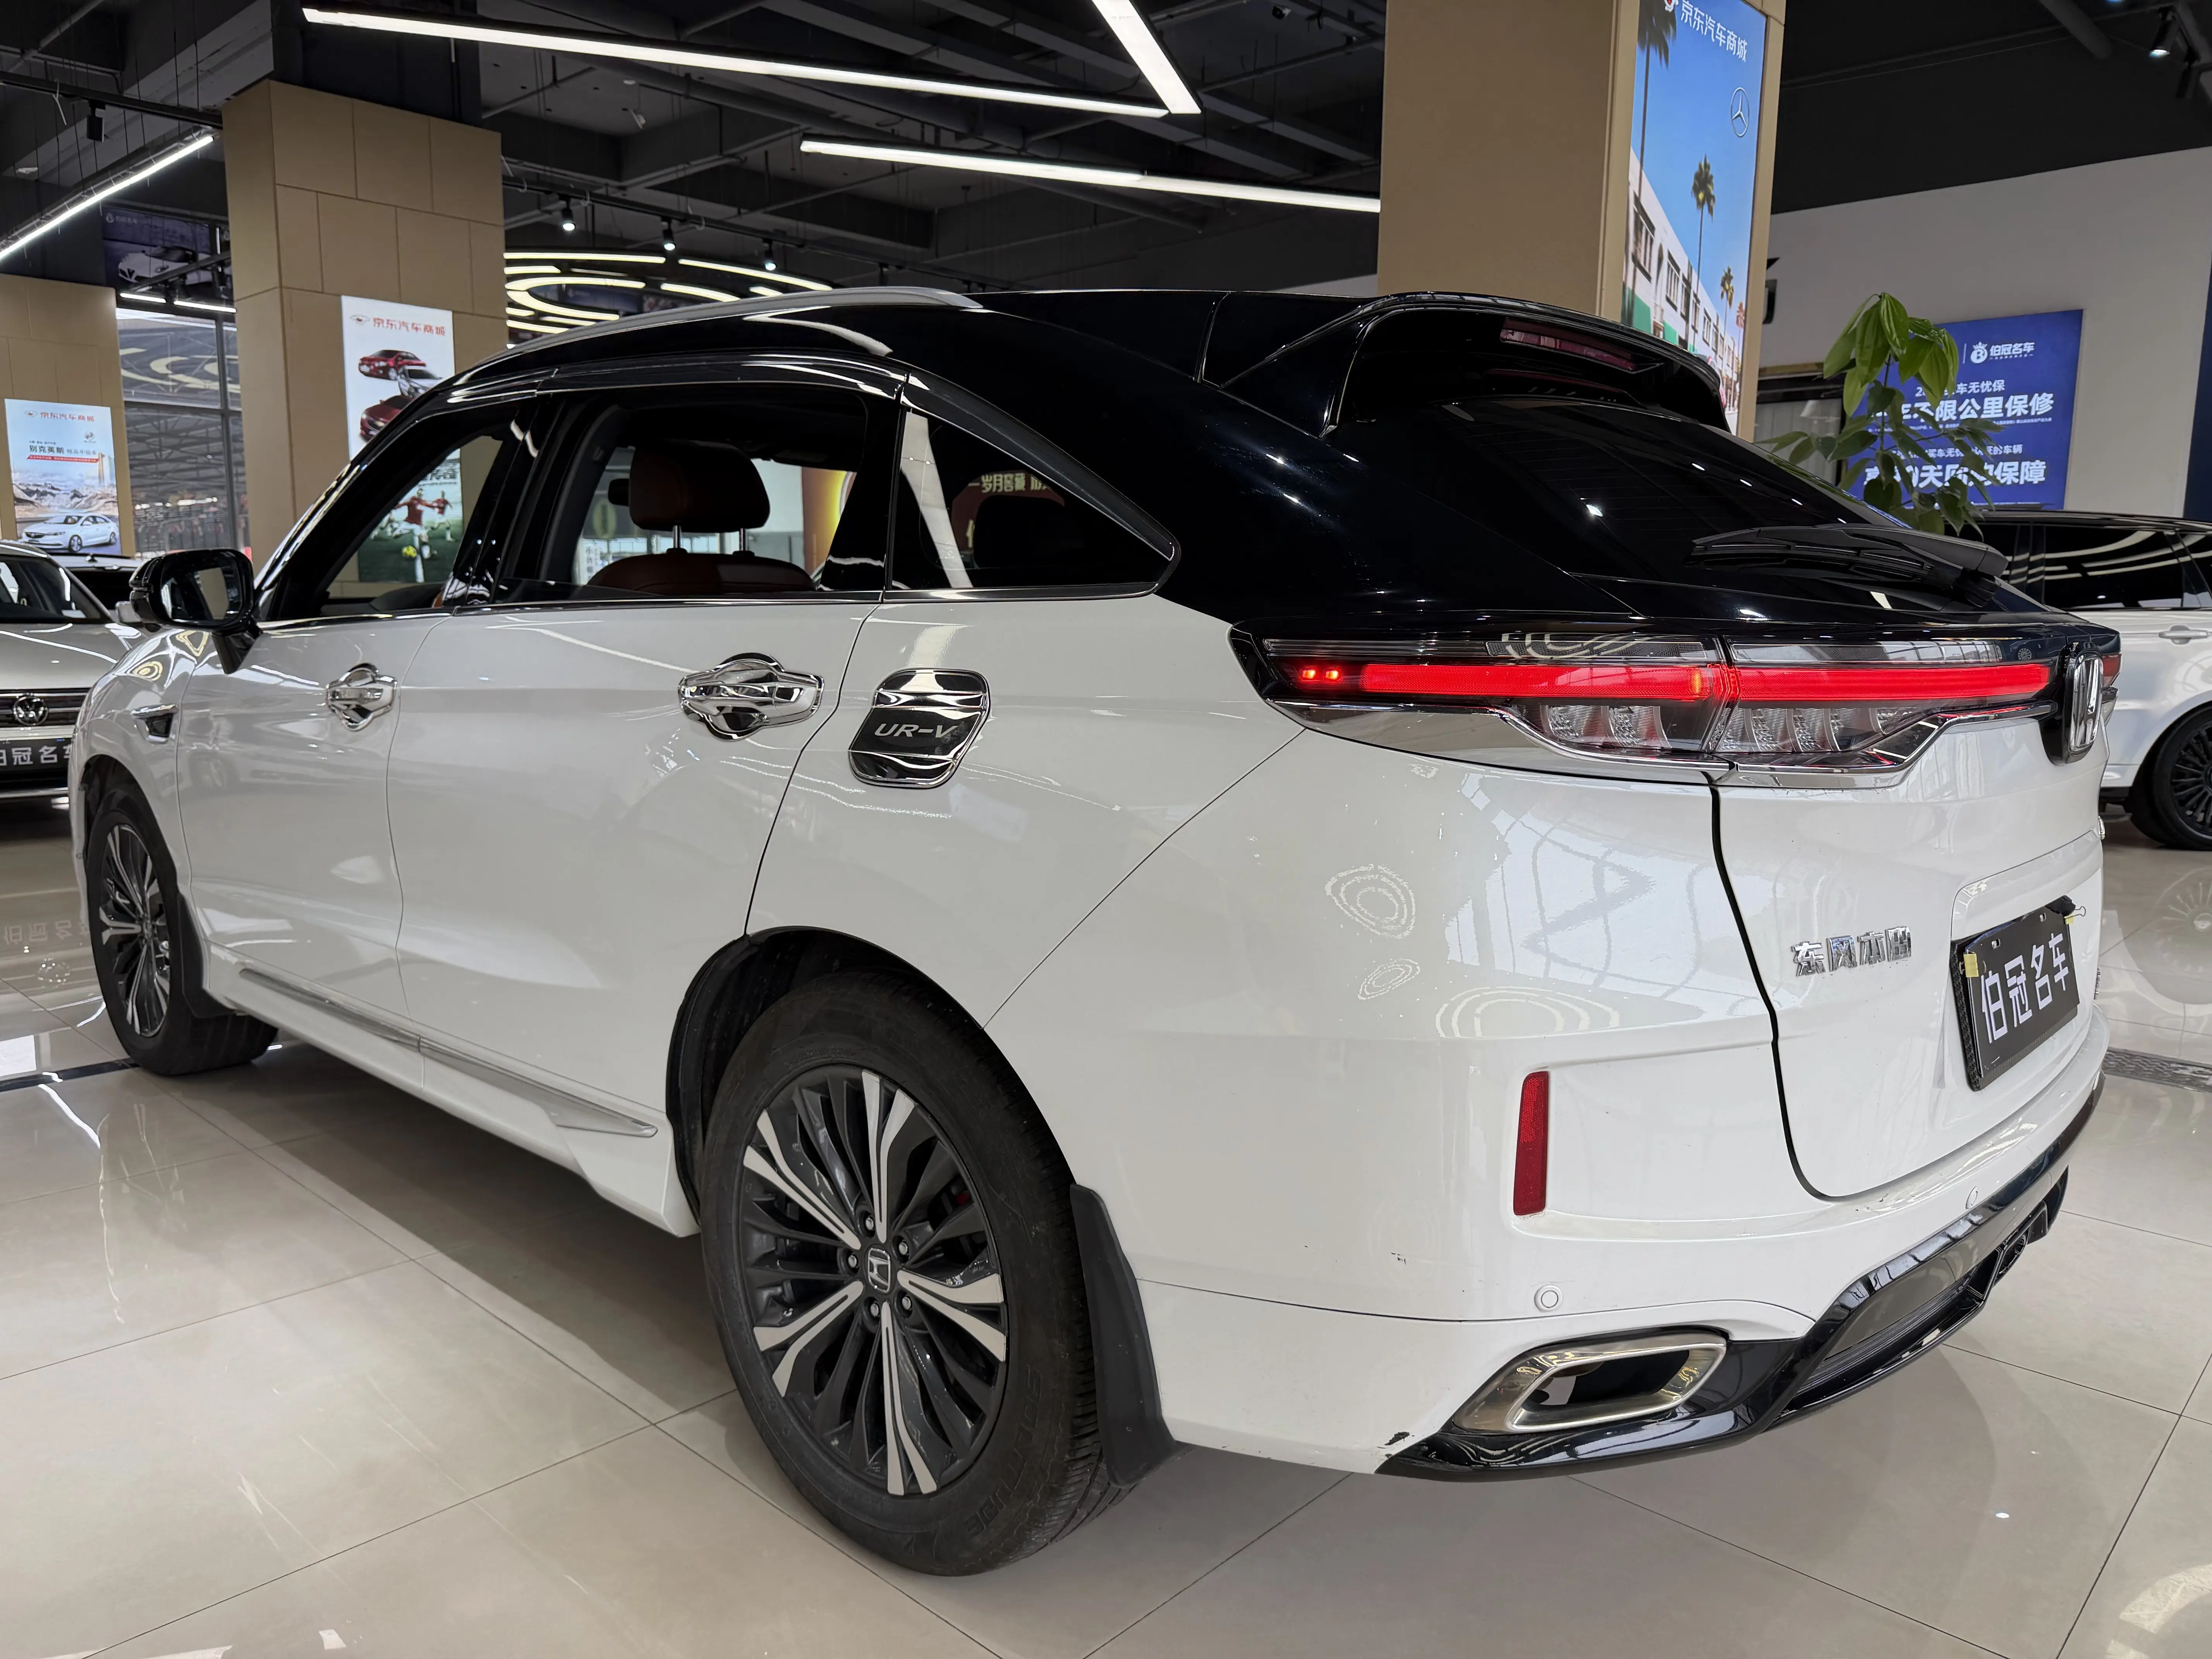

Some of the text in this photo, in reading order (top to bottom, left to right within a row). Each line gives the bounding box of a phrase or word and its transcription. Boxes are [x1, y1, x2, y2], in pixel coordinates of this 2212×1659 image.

[1680, 0, 1748, 62] 京东汽车商城
[373, 317, 445, 336] 京东汽车商城
[1990, 342, 2035, 356] 伯冠名车
[874, 723, 958, 738] UR-V
[1792, 926, 1912, 977] 东风本田
[1981, 932, 2070, 1044] 伯冠名车
